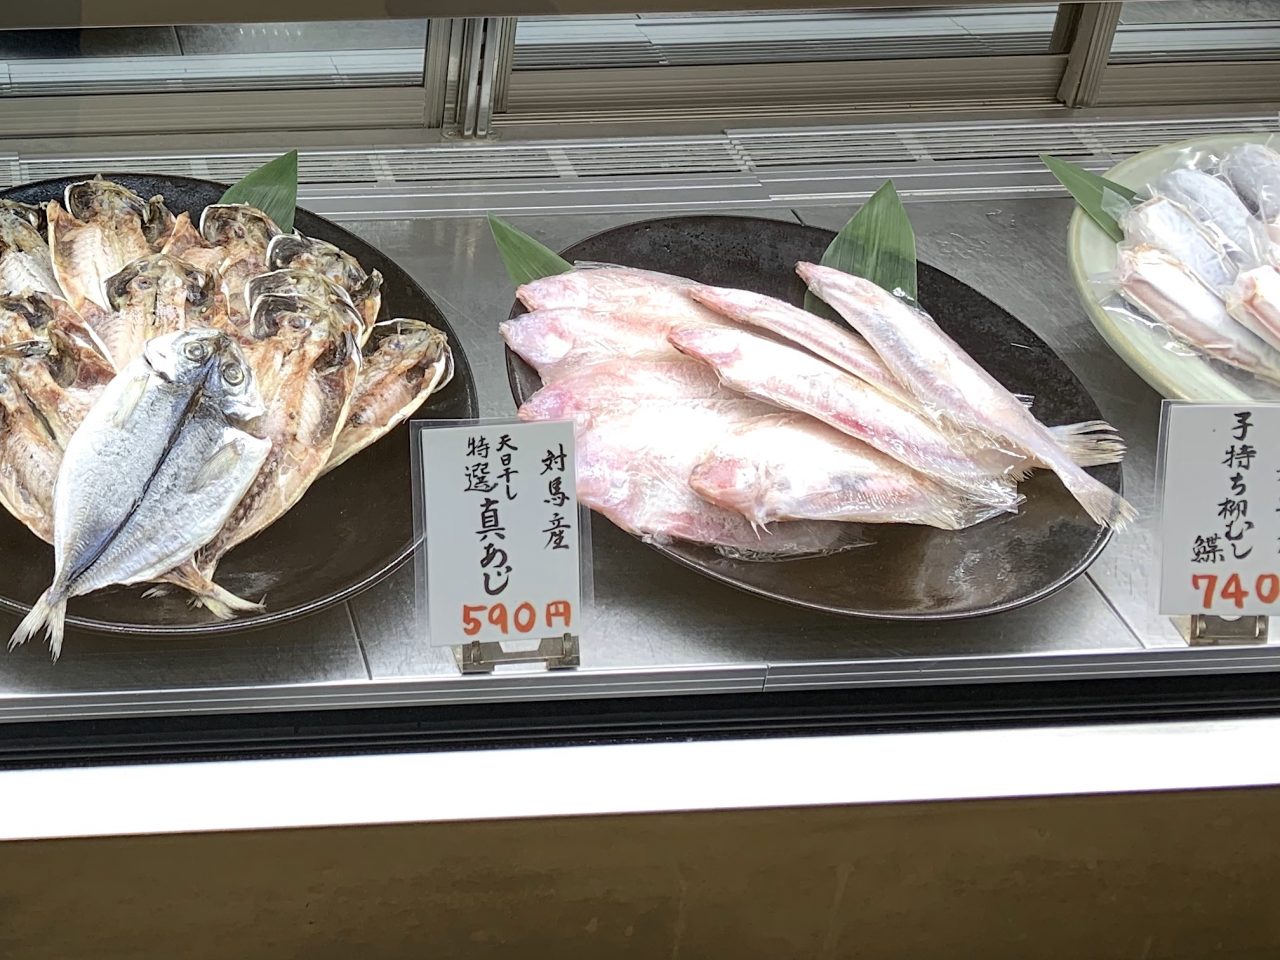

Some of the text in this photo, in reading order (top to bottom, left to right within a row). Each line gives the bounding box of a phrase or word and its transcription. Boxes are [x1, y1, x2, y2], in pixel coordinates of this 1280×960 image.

[463, 435, 499, 493] 特選
[495, 433, 519, 501] 天日干し
[1217, 410, 1258, 561] 子持ち柳むし
[539, 442, 571, 551] 対馬産
[475, 497, 513, 597] 真あじ
[1190, 532, 1225, 564] 鰈
[462, 599, 572, 636] 590円
[1191, 572, 1280, 610] 740
